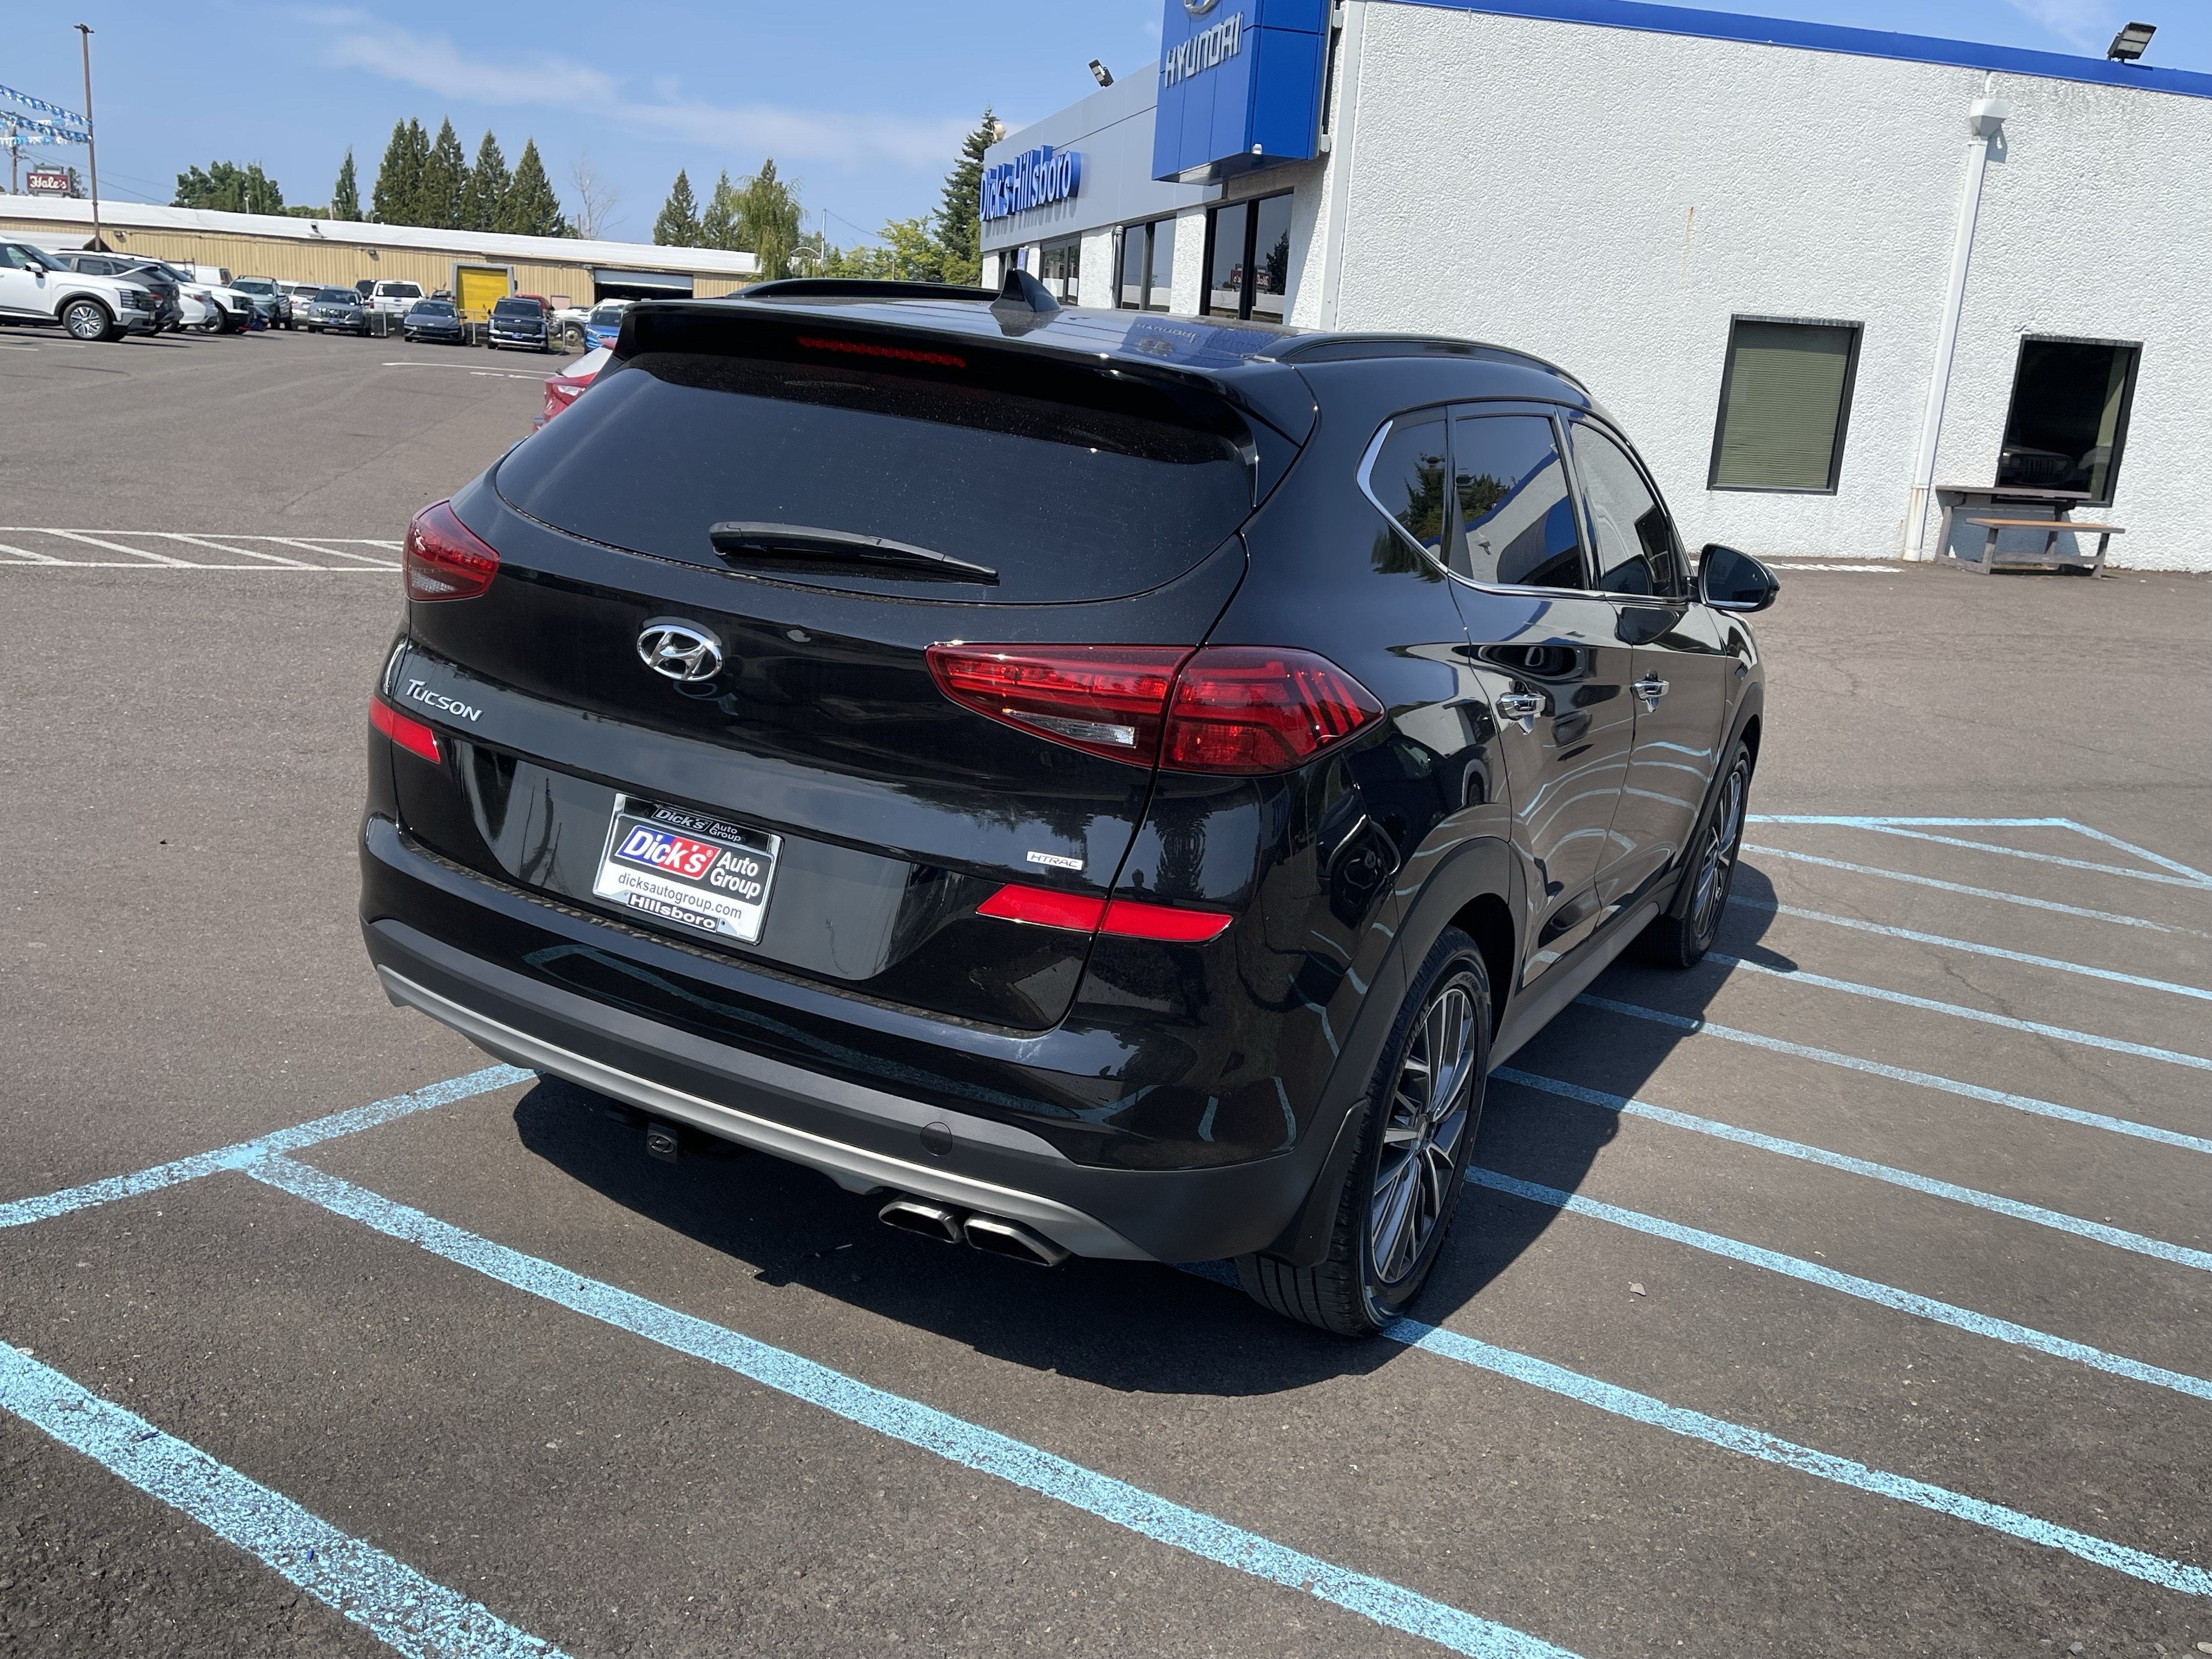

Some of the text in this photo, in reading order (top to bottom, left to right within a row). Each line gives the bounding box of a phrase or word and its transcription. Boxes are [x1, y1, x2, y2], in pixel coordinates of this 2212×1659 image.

[1165, 11, 1243, 88] HYUNDAI
[30, 175, 67, 189] Hale's
[979, 145, 1074, 222] Dick's Hillsboro
[656, 809, 706, 830] Dick's
[713, 823, 738, 834] Auto
[709, 828, 741, 842] Group
[623, 830, 707, 873] Dick's
[716, 851, 758, 877] Auto
[1030, 854, 1079, 867] HTRAC
[618, 872, 742, 919] dicksautogroup.com
[710, 867, 760, 899] Group
[630, 894, 715, 928] Hillsboro
